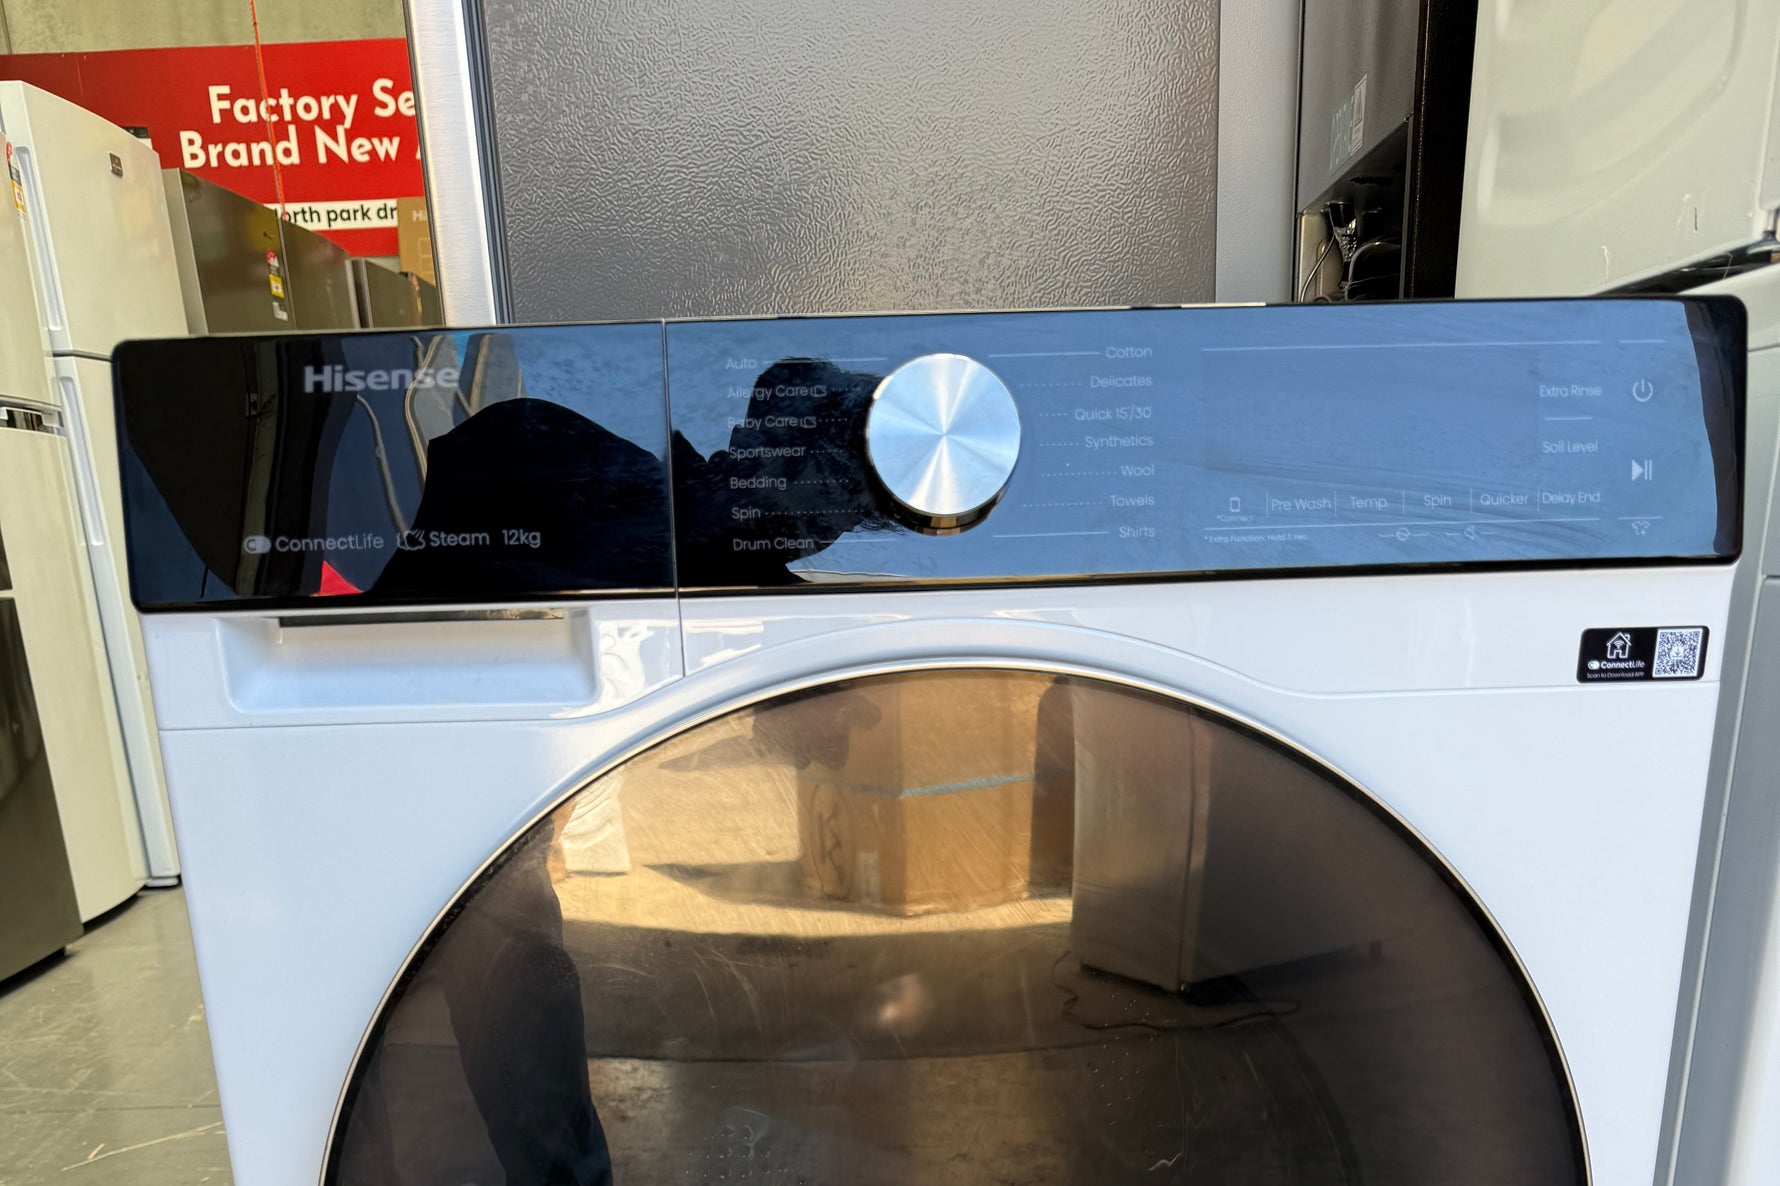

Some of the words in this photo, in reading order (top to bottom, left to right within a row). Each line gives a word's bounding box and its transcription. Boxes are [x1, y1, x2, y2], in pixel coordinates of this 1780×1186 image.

[208, 85, 358, 130] Factory
[372, 78, 416, 118] Se
[179, 124, 300, 169] Brand
[314, 125, 400, 164] New
[274, 207, 321, 226] orth
[327, 206, 372, 228] park
[1105, 347, 1152, 359] Cotton
[726, 357, 757, 370] Auto
[304, 364, 459, 393] Hisense
[1090, 375, 1153, 388] Delicates
[727, 385, 772, 400] Allergy
[775, 385, 808, 398] Care
[1539, 385, 1569, 398] Extra
[1570, 385, 1602, 397] Rinse
[1074, 408, 1112, 421] Quick
[727, 416, 761, 431] Baby
[765, 416, 798, 428] Care
[1085, 435, 1154, 450] Synthetics
[1542, 441, 1564, 454] Soil
[1567, 441, 1599, 452] Level
[729, 446, 806, 460] Sportswear
[1120, 465, 1154, 476] Wool
[730, 476, 787, 491] Bedding
[1110, 494, 1155, 507] Towels
[1271, 498, 1291, 511] Pre
[1294, 498, 1331, 510] Wash
[1423, 495, 1452, 509] Spin
[1480, 493, 1529, 506] Quicker
[1542, 492, 1575, 506] Delay
[1577, 491, 1600, 503] End
[732, 507, 761, 521] Spin
[1119, 526, 1155, 539] Shirts
[275, 533, 384, 552] ConnectLife
[430, 530, 490, 547] Steam
[502, 529, 541, 548] 12kg
[733, 538, 771, 551] Drum
[774, 537, 815, 550] Clean
[1600, 661, 1645, 669] ConnectLife
